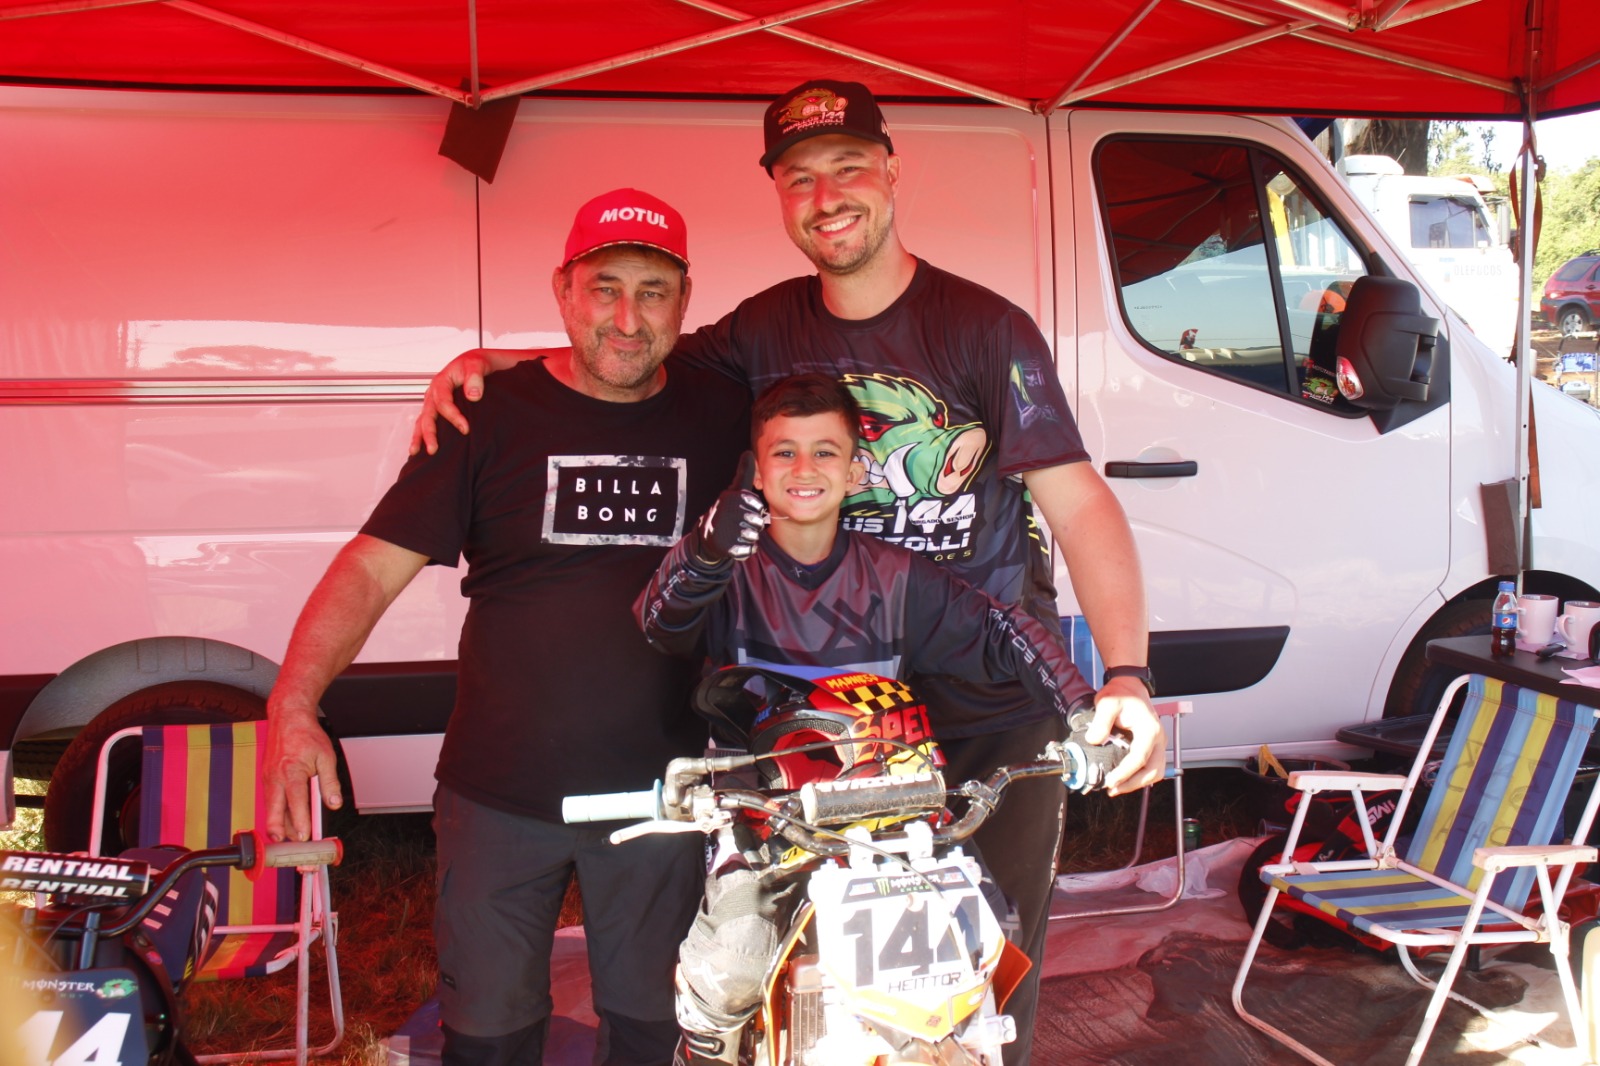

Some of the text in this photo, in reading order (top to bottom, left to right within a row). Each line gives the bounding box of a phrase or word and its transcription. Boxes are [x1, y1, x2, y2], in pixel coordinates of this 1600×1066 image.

[598, 207, 669, 229] MOTUL
[575, 477, 662, 495] BILLA
[577, 505, 657, 522] BONG
[893, 493, 976, 534] 144
[1, 855, 134, 881] RENTHAL
[0, 877, 129, 898] RENTHAL
